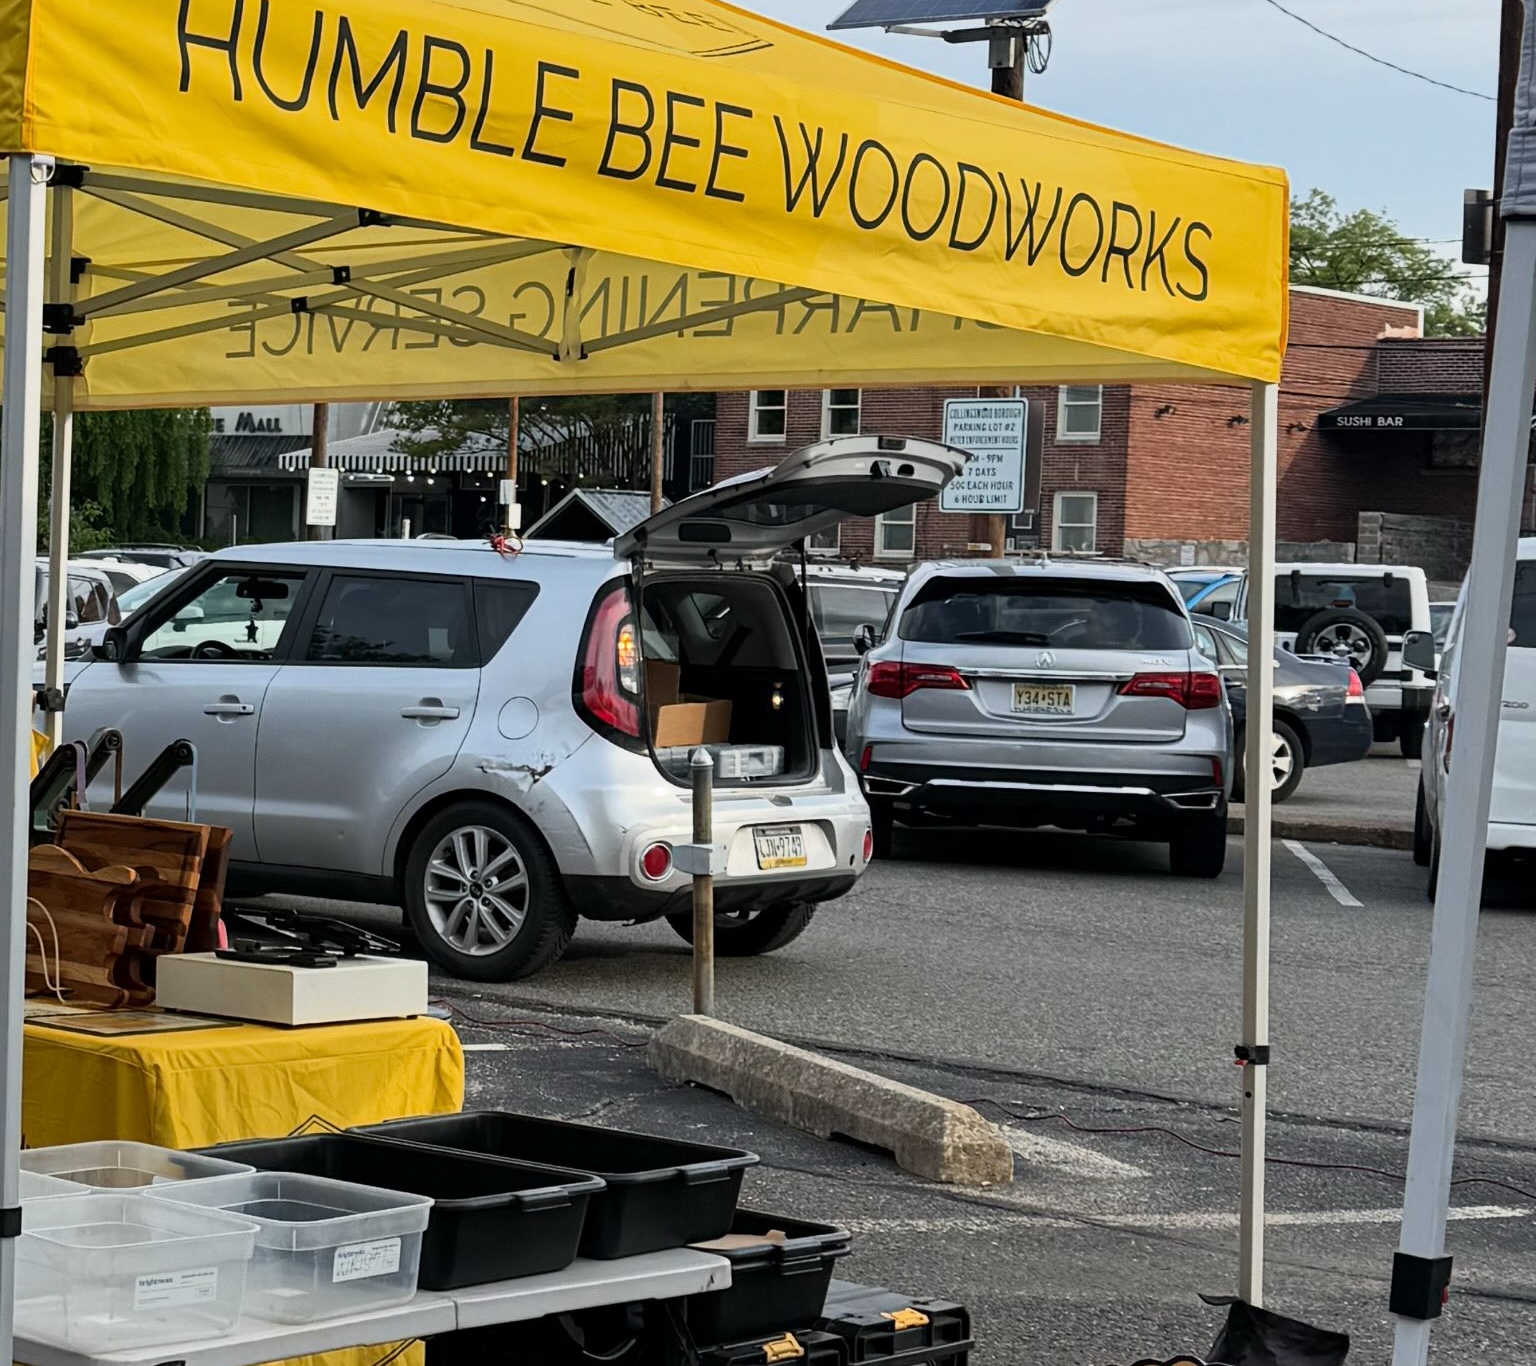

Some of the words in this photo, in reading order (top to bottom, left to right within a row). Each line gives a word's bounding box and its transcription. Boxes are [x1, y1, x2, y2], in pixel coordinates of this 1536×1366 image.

[598, 78, 756, 204] BEE
[774, 114, 1213, 303] WOODWORKS
[1336, 416, 1372, 426] SUSHI
[1377, 417, 1403, 426] BAR
[953, 423, 986, 431] PARKING
[988, 423, 1002, 431] LOT
[968, 468, 972, 476] 7
[975, 468, 996, 476] DAYS
[967, 481, 988, 490] EACH
[990, 481, 1014, 490] HOUR
[962, 495, 983, 504] HOUR
[986, 495, 1007, 503] LIMIT
